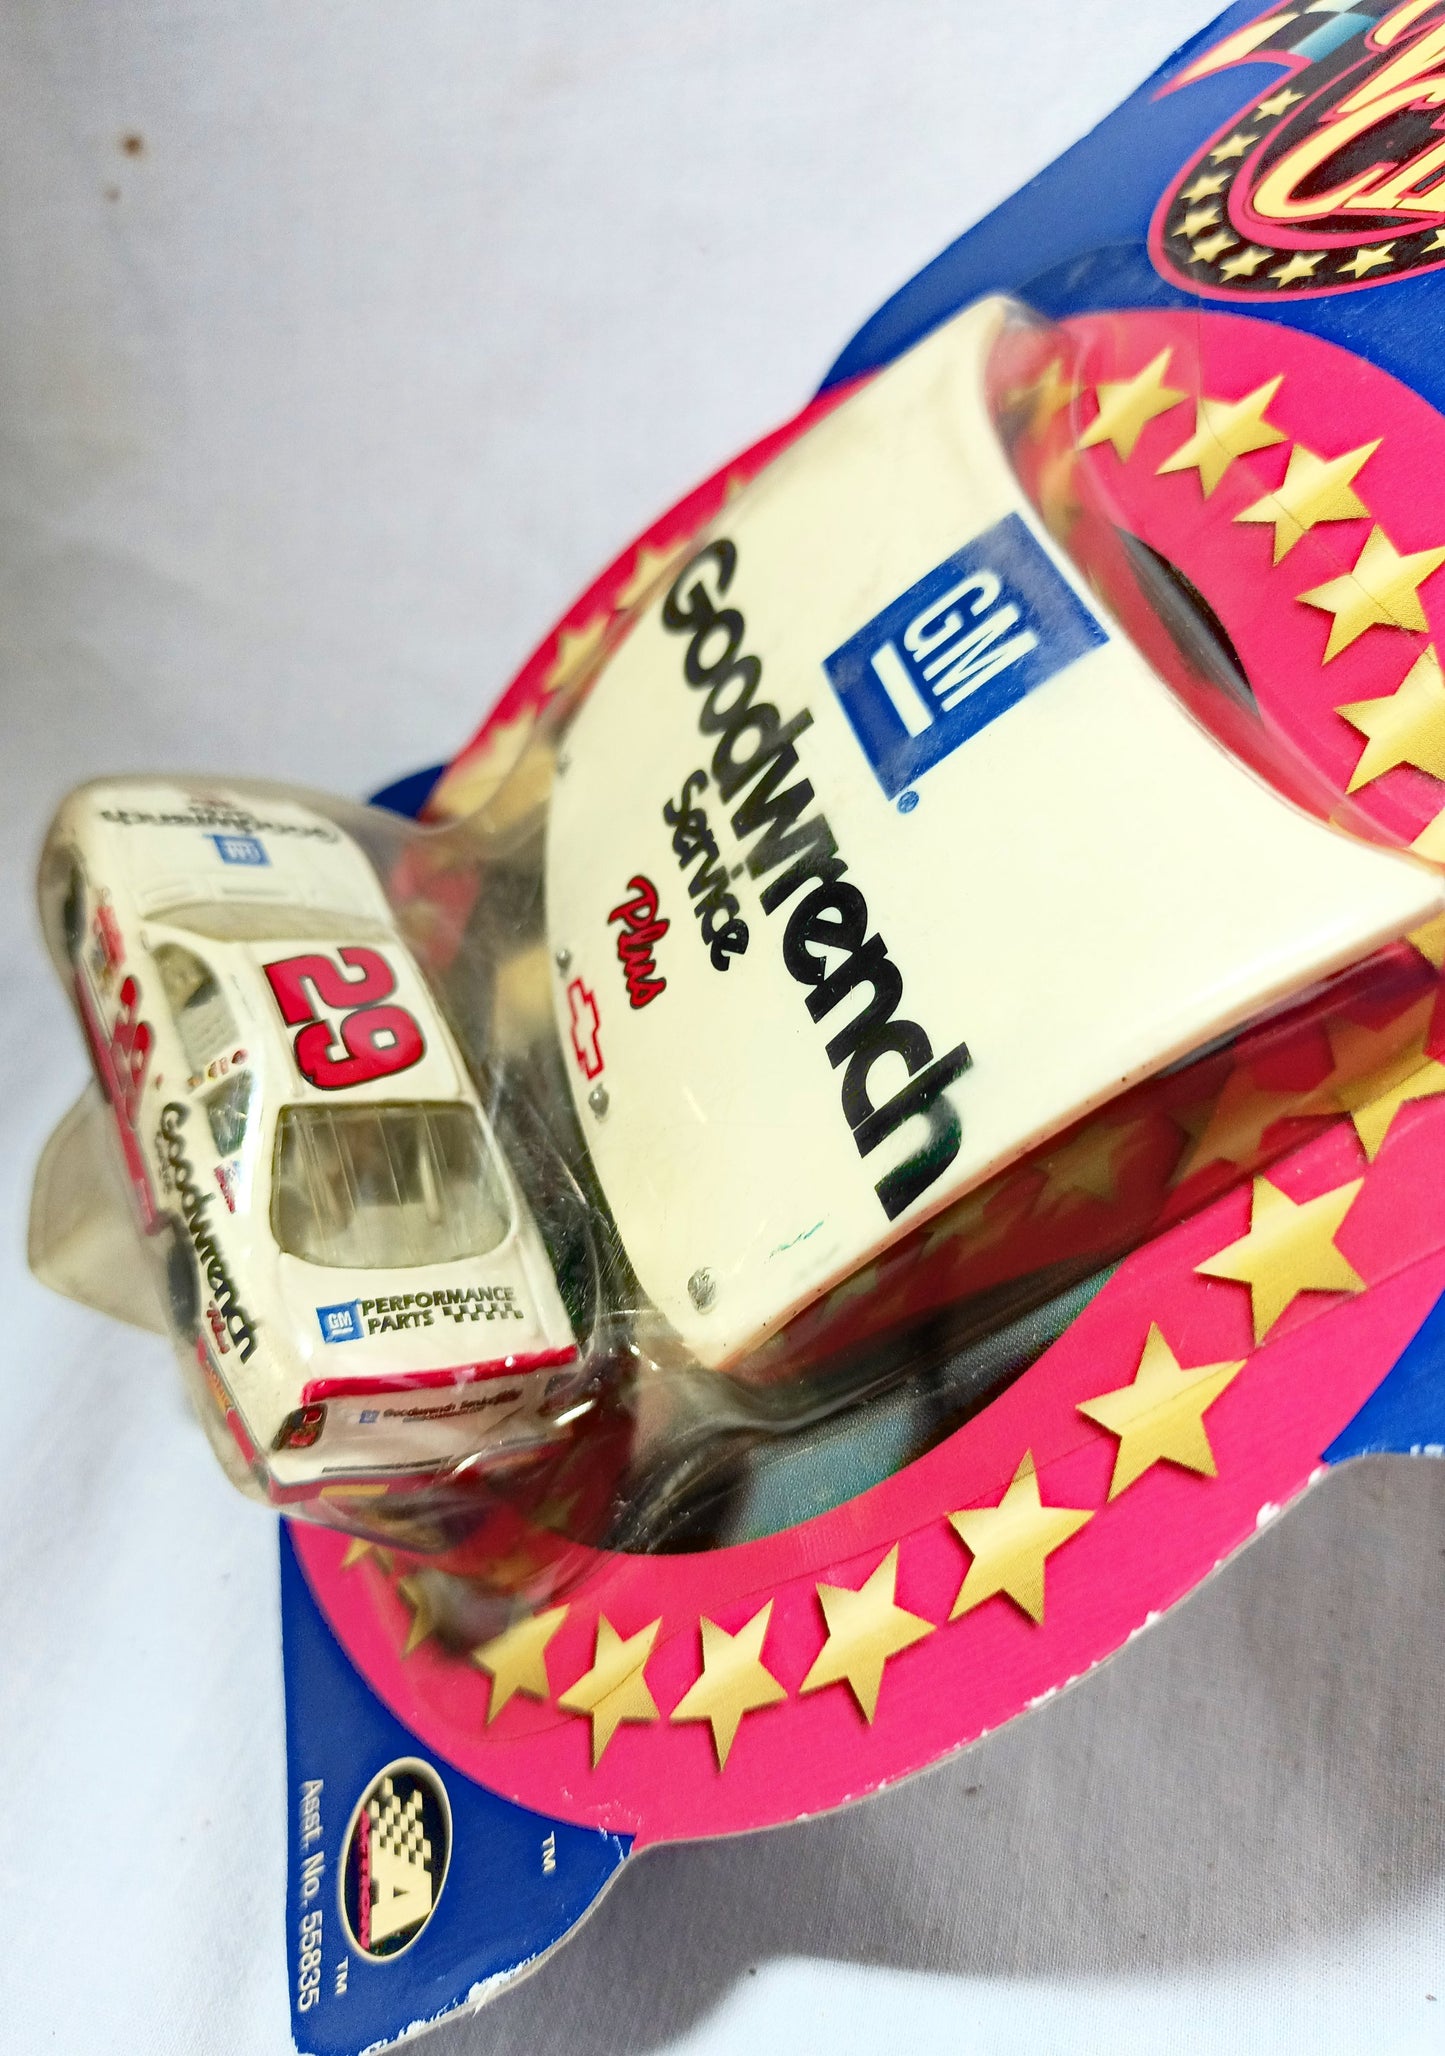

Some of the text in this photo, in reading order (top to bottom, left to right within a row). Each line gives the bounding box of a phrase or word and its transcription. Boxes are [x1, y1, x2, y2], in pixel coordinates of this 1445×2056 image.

[903, 570, 1038, 712] GM
[661, 539, 974, 1222] Goodwrench
[662, 767, 750, 972] Service
[607, 874, 671, 1010] Plus
[262, 946, 428, 1091] 29
[161, 1102, 259, 1364] Goodwrench
[361, 1286, 515, 1316] PERFORMANCE
[327, 1310, 353, 1330] GM
[367, 1309, 435, 1335] PARTS
[298, 1779, 325, 2012] Asst. No. 55835
[335, 1956, 348, 1995] TM
